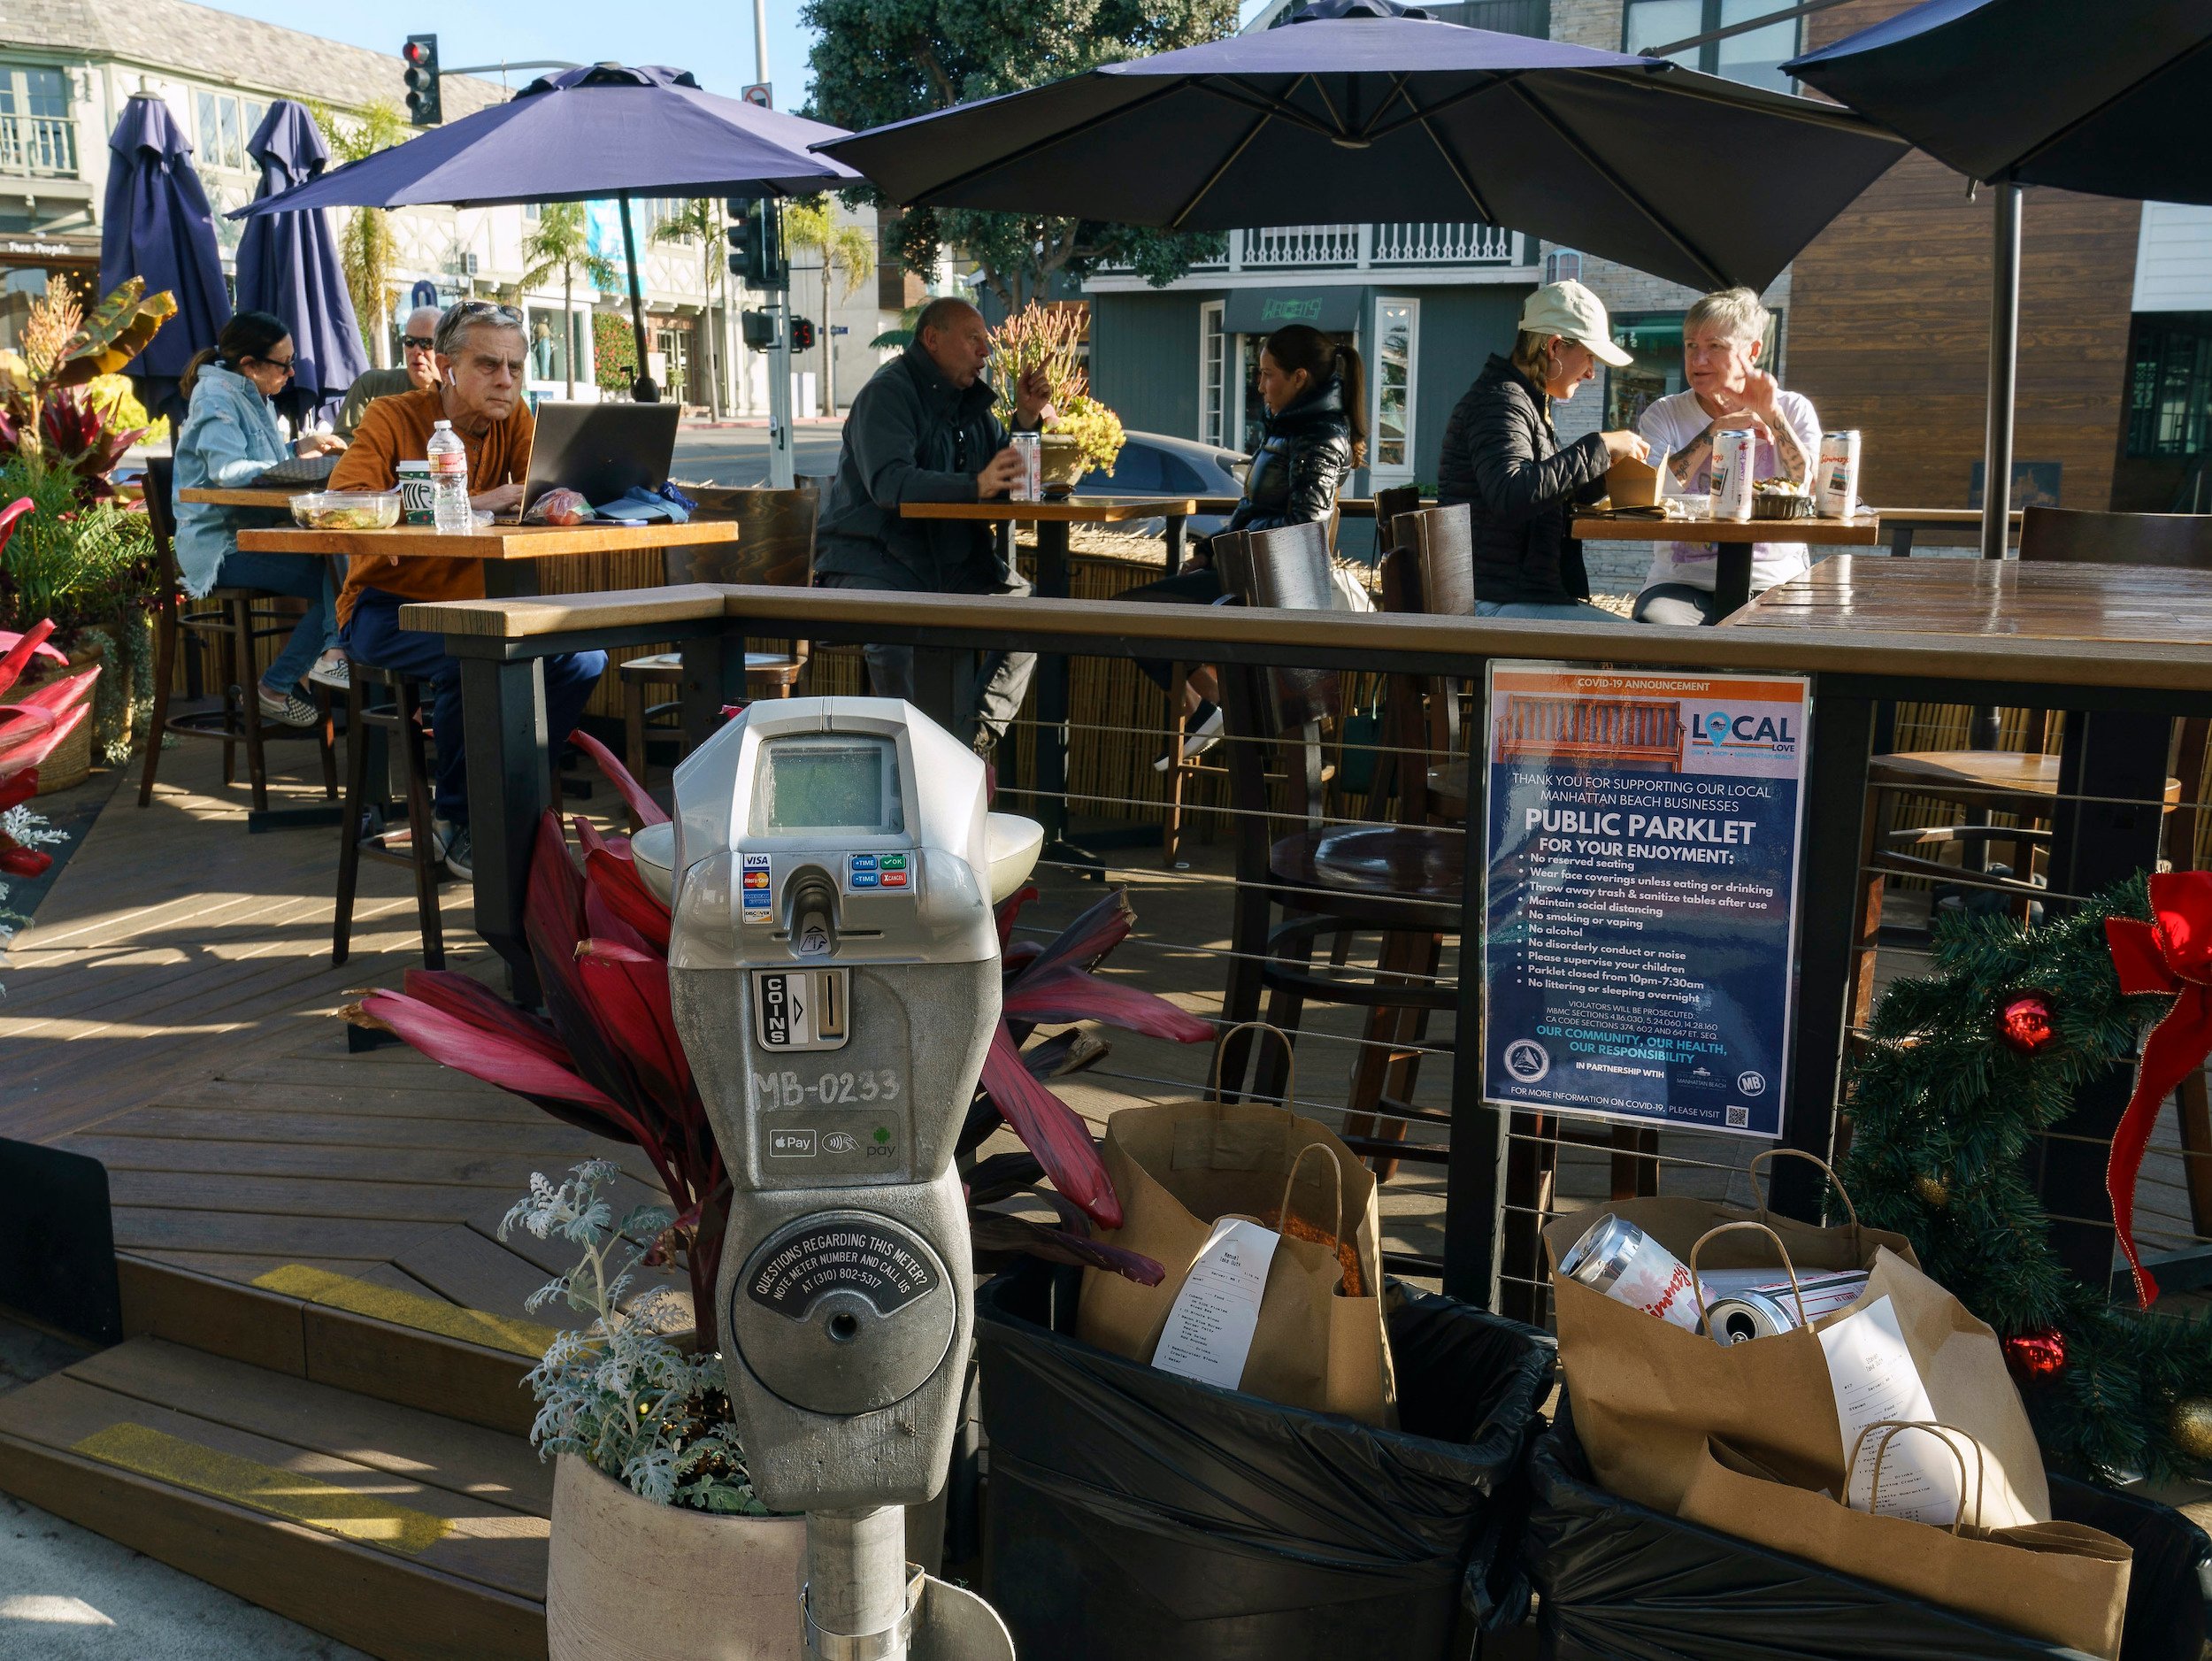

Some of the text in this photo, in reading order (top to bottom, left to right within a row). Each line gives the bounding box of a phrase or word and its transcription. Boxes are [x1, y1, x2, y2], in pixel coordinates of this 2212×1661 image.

[1578, 677, 1709, 692] COVID-19 ANNOUNCEMENT
[1692, 711, 1795, 746] LOCAL
[1771, 743, 1794, 752] LOVE
[1512, 772, 1771, 800] THANK YOU FOR SUPPORTING OUR LOCAL
[1540, 788, 1740, 813] MANHATTAN BEACH BUSINESSES
[1525, 806, 1756, 847] PUBLIC PARKLET
[747, 856, 768, 865] VISA
[1530, 853, 1634, 872] No reserved seating
[1539, 836, 1735, 865] FOR YOUR ENJOYMENT:
[1530, 867, 1558, 878] Wear
[1560, 870, 1582, 880] face
[1584, 872, 1635, 886] coverings
[1637, 876, 1671, 887] unless
[1672, 879, 1708, 892] eating
[1725, 883, 1774, 897] drinking
[1529, 881, 1767, 910] Throw away trash & sanitize tables after use
[1529, 896, 1663, 919] Maintain social distancing
[1528, 924, 1582, 937] No alcohol
[1529, 910, 1544, 919] No
[1546, 911, 1589, 925] smoking
[1605, 917, 1643, 930] vaping
[1528, 937, 1543, 947] No
[1545, 939, 1598, 954] disorderly
[1600, 944, 1641, 956] conduct
[1657, 950, 1686, 960] noise
[1528, 950, 1685, 974] Please supervise your children
[1528, 964, 1704, 991] Parklet closed from 10pm-7:30am
[1528, 978, 1543, 987] No
[1544, 980, 1586, 993] littering
[1601, 985, 1646, 999] sleeping
[1647, 989, 1700, 1005] overnight
[767, 978, 786, 1043] COINS
[1546, 1005, 1570, 1015] MBMC
[1571, 1009, 1609, 1019] SECTIONS
[1568, 999, 1611, 1011] VIOLATORS
[1612, 1004, 1631, 1013] WILL
[1545, 1014, 1556, 1023] CA
[1557, 1016, 1579, 1026] CODE
[1581, 1019, 1618, 1030] SECTIONS
[1636, 1024, 1652, 1034] 602
[1654, 1027, 1672, 1036] AND
[1672, 1028, 1686, 1037] 647
[1536, 1024, 1727, 1057] OUR COMMUNITY, OUR HEALTH,
[1569, 1040, 1694, 1065] OUR RESPONSIBILITY
[1586, 1062, 1641, 1076] PARTNERSHIP
[1642, 1069, 1664, 1079] WTIH
[1677, 1078, 1708, 1087] MANHATTAN
[1740, 1075, 1761, 1091] MB
[752, 1069, 900, 1111] MB-0233
[1510, 1085, 1527, 1095] FOR
[1528, 1088, 1551, 1098] MORE
[1553, 1090, 1609, 1105] INFORMATION
[1610, 1097, 1624, 1107] ON
[1668, 1105, 1699, 1117] PLEASE
[1701, 1109, 1720, 1119] VISIT
[787, 1136, 810, 1150] Pay
[867, 1145, 895, 1157] pay
[756, 1234, 928, 1296] QUESTIONS REGARDING THIS METER?
[773, 1251, 911, 1301] NOTE METER NUMBER AND CALL US
[802, 1268, 882, 1294] AT (310) 802-5317
[1638, 1262, 1692, 1319] immzy's
